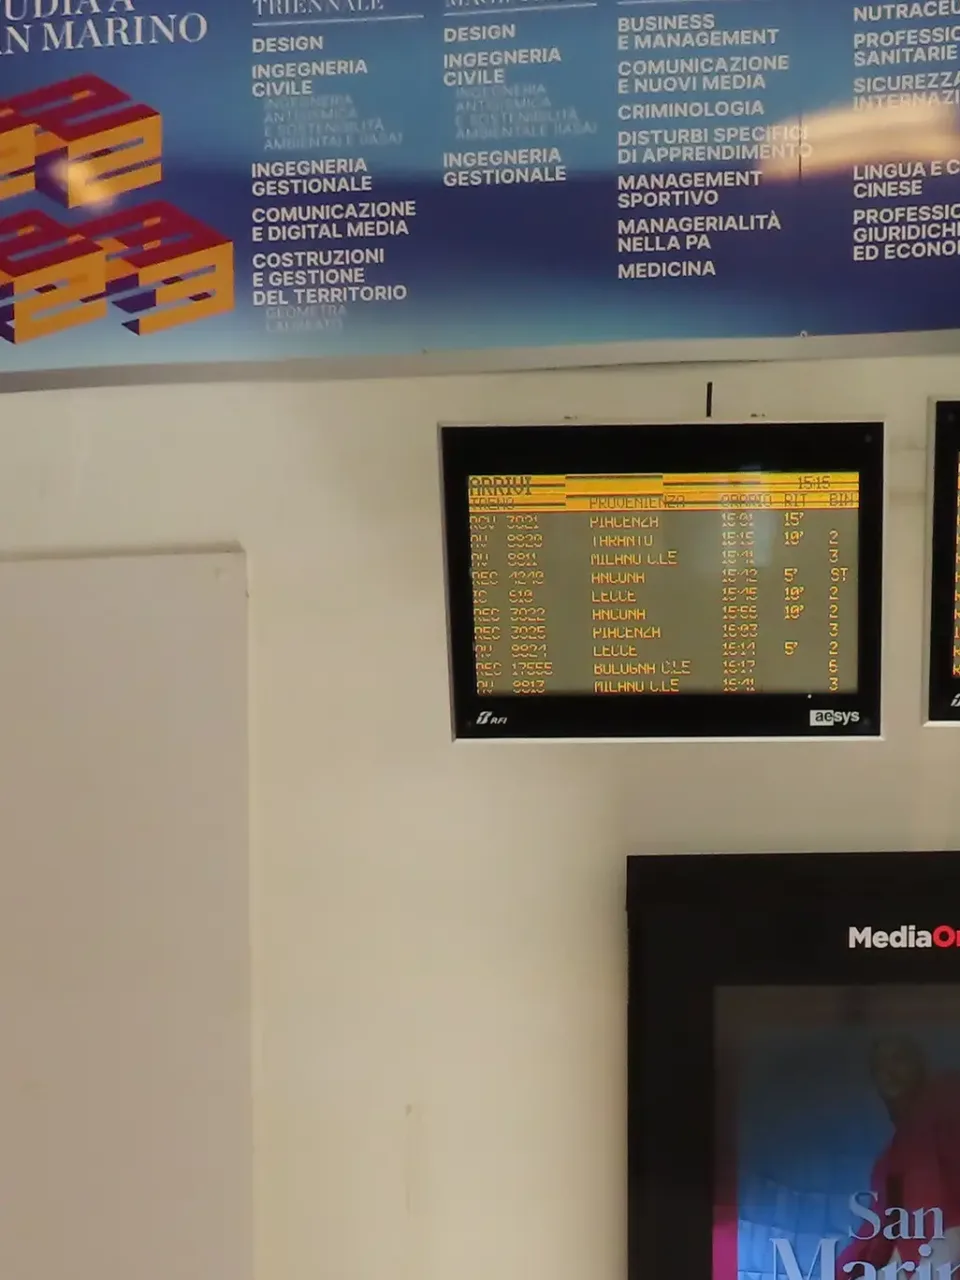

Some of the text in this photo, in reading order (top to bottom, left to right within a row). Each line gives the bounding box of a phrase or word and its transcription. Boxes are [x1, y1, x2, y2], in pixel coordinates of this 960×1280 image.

[253, 0, 384, 16] TRIENNALE
[42, 12, 208, 52] MARINO
[444, 24, 516, 42] DESIGN
[617, 13, 715, 33] BUSINESS
[252, 36, 323, 53] DESIGN
[617, 29, 779, 50] E MANAGEMENT
[444, 48, 562, 69] INGEGNERIA
[617, 55, 789, 76] COMUNICAZIONE
[853, 44, 958, 67] SANITARIE
[252, 59, 368, 79] INGEGNERIA
[444, 69, 505, 86] CIVILE
[252, 80, 312, 97] CIVILE
[618, 74, 766, 94] E NUOVI MEDIA
[617, 100, 765, 120] CRIMINOLOGIA
[617, 128, 708, 147] DISTURBI
[713, 125, 809, 143] SPECIFICI
[443, 148, 561, 167] INGEGNERIA
[618, 143, 813, 164] DI APPRENDIMENTO
[252, 158, 367, 178] INGEGNERIA
[443, 166, 566, 186] GESTIONALE
[853, 162, 926, 181] LINGUA
[930, 160, 942, 176] E
[252, 176, 372, 197] GESTIONALE
[617, 171, 763, 190] MANAGEMENT
[853, 180, 922, 198] CINESE
[617, 190, 719, 209] SPORTIVO
[252, 201, 416, 223] COMUNICAZIONE
[252, 220, 409, 242] E DIGITAL MEDIA
[617, 210, 782, 235] MANAGERIALITÀ
[618, 234, 711, 253] NELLA PA
[853, 245, 879, 261] ED
[252, 248, 384, 269] COSTRUZIONI
[253, 268, 365, 287] E GESTIONE
[617, 260, 716, 279] MEDICINA
[253, 285, 407, 306] DEL TERRITORIO
[470, 476, 831, 496] ARRIVI 15:15
[784, 493, 807, 507] RIT
[829, 493, 854, 507] BIN
[814, 710, 861, 726] aesys
[848, 1190, 946, 1241] San
